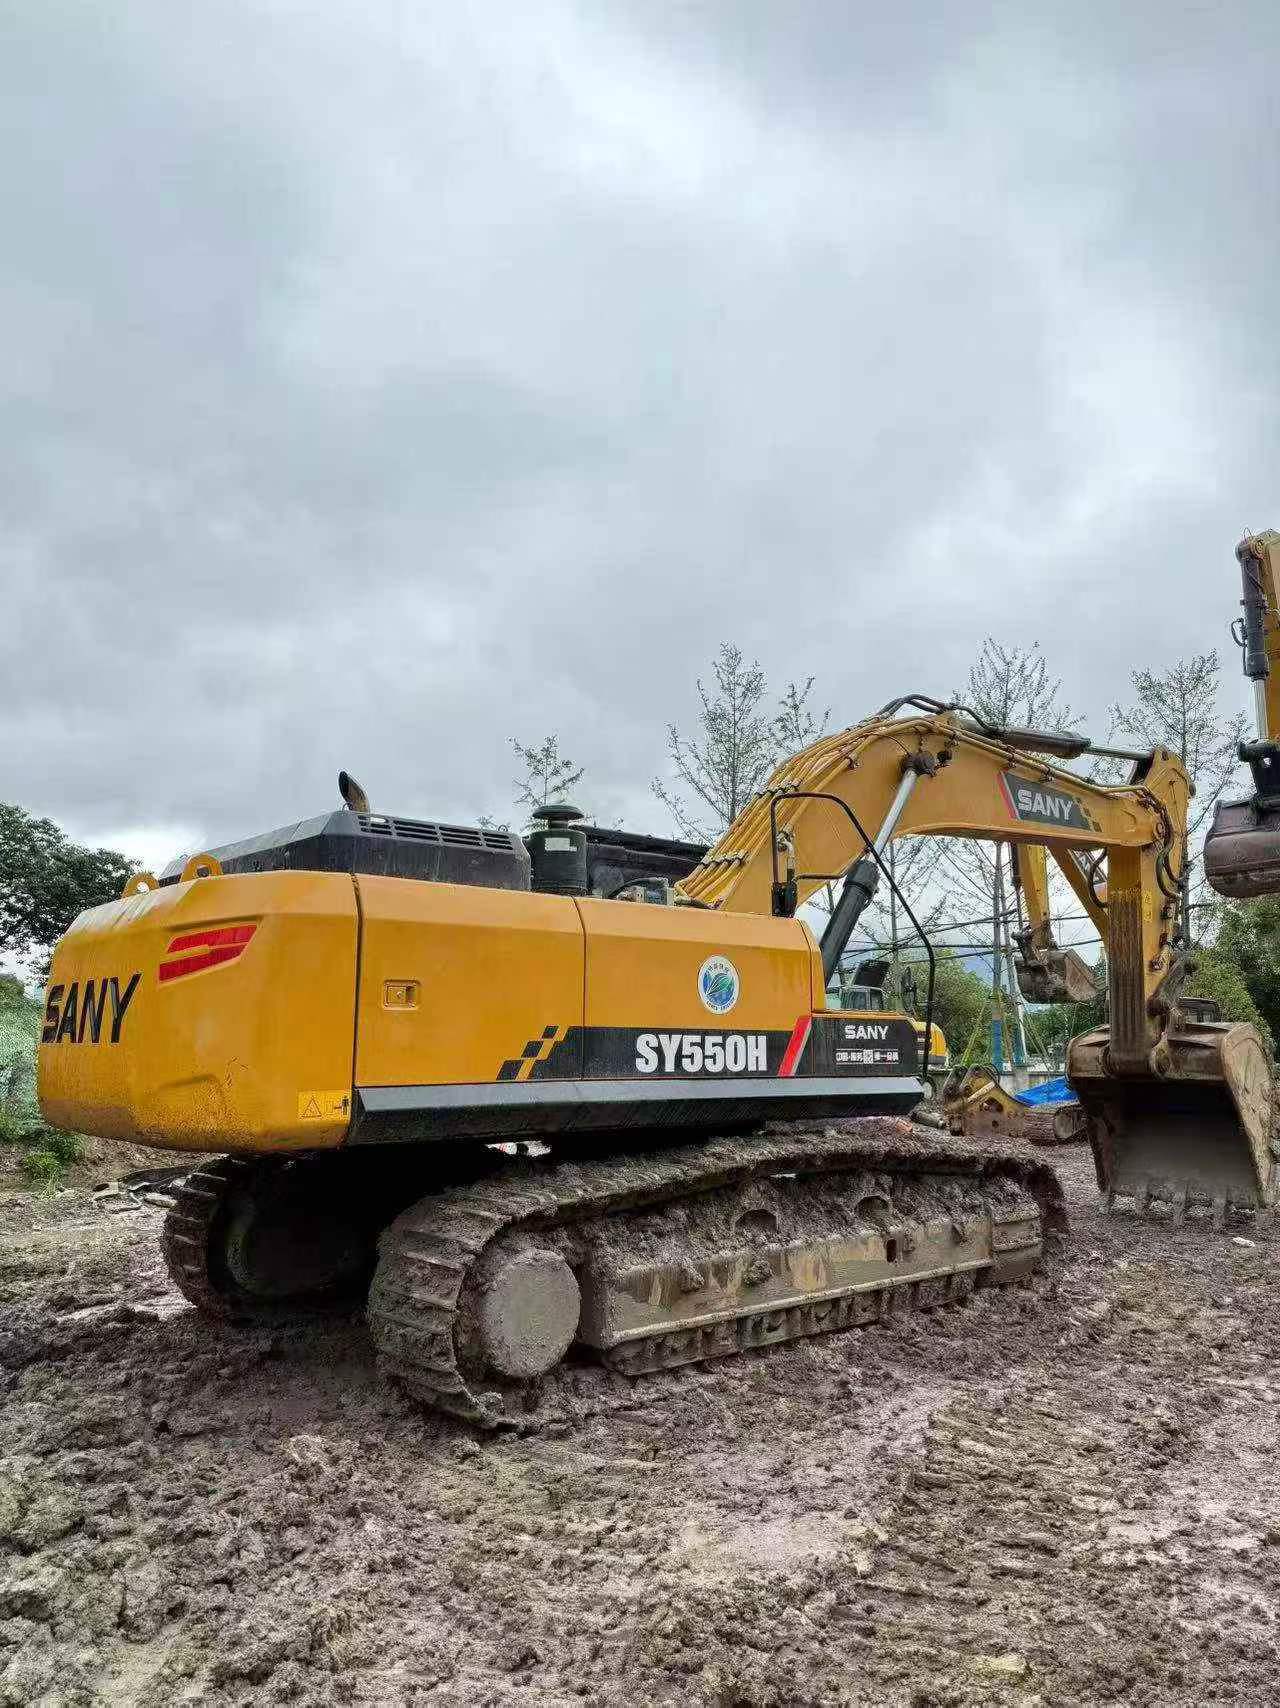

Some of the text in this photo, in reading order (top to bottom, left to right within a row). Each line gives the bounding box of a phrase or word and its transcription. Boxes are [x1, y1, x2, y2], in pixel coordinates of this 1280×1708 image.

[1017, 789, 1073, 820] SANY
[42, 972, 142, 1043] SANY
[844, 1025, 889, 1039] SANY
[635, 1033, 768, 1073] SY550H
